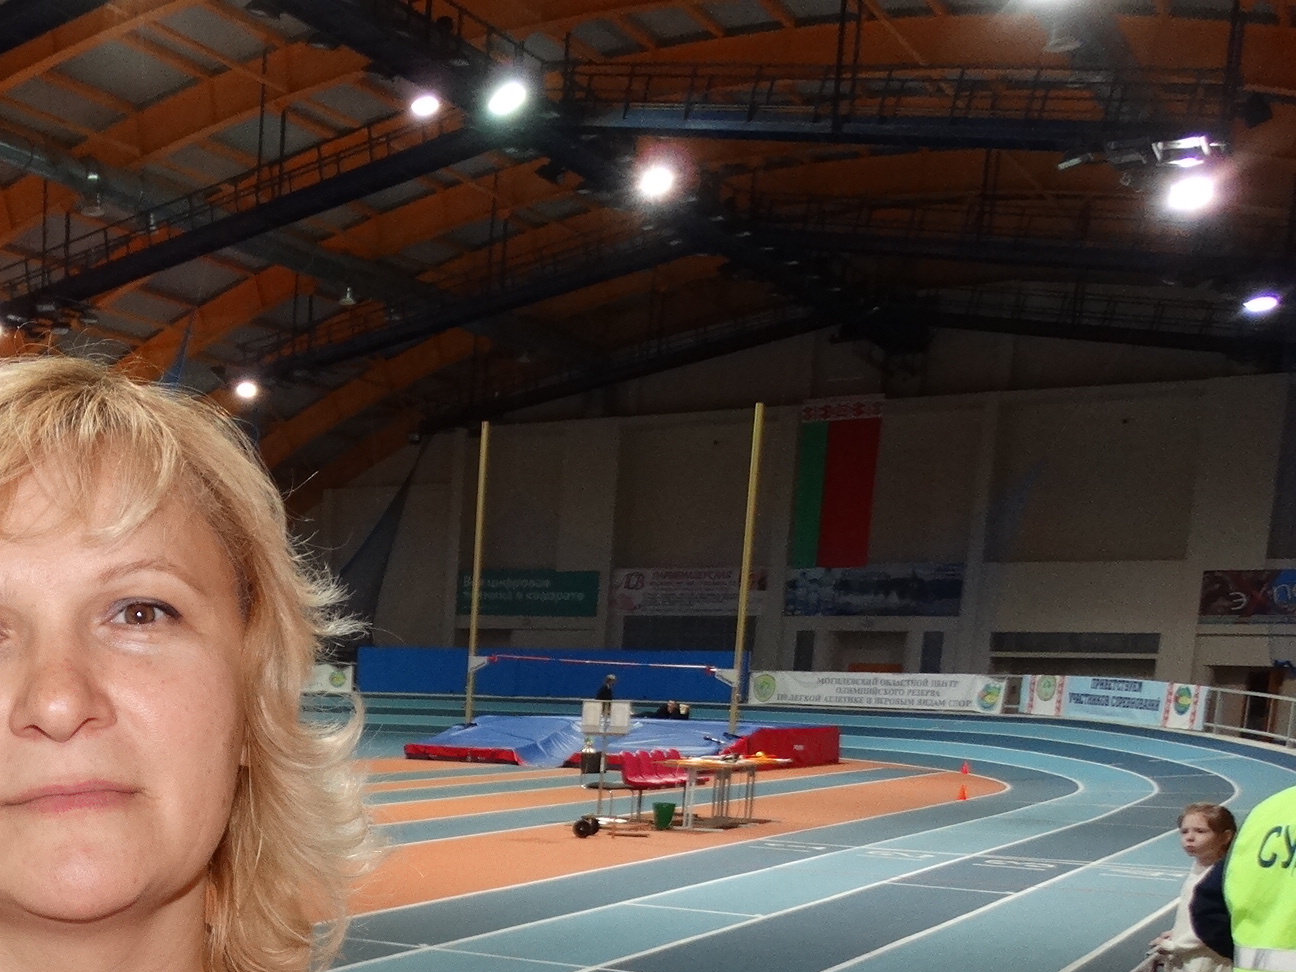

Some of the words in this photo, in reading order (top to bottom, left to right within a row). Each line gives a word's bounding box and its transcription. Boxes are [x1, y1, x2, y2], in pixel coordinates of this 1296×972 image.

[817, 677, 878, 686] МОГИЛЕВСКИЙ
[880, 678, 929, 687] ОБЛАСТНОЙ
[907, 688, 941, 697] РЕЗЕРВА
[788, 693, 822, 702] ЛЕГКОЙ
